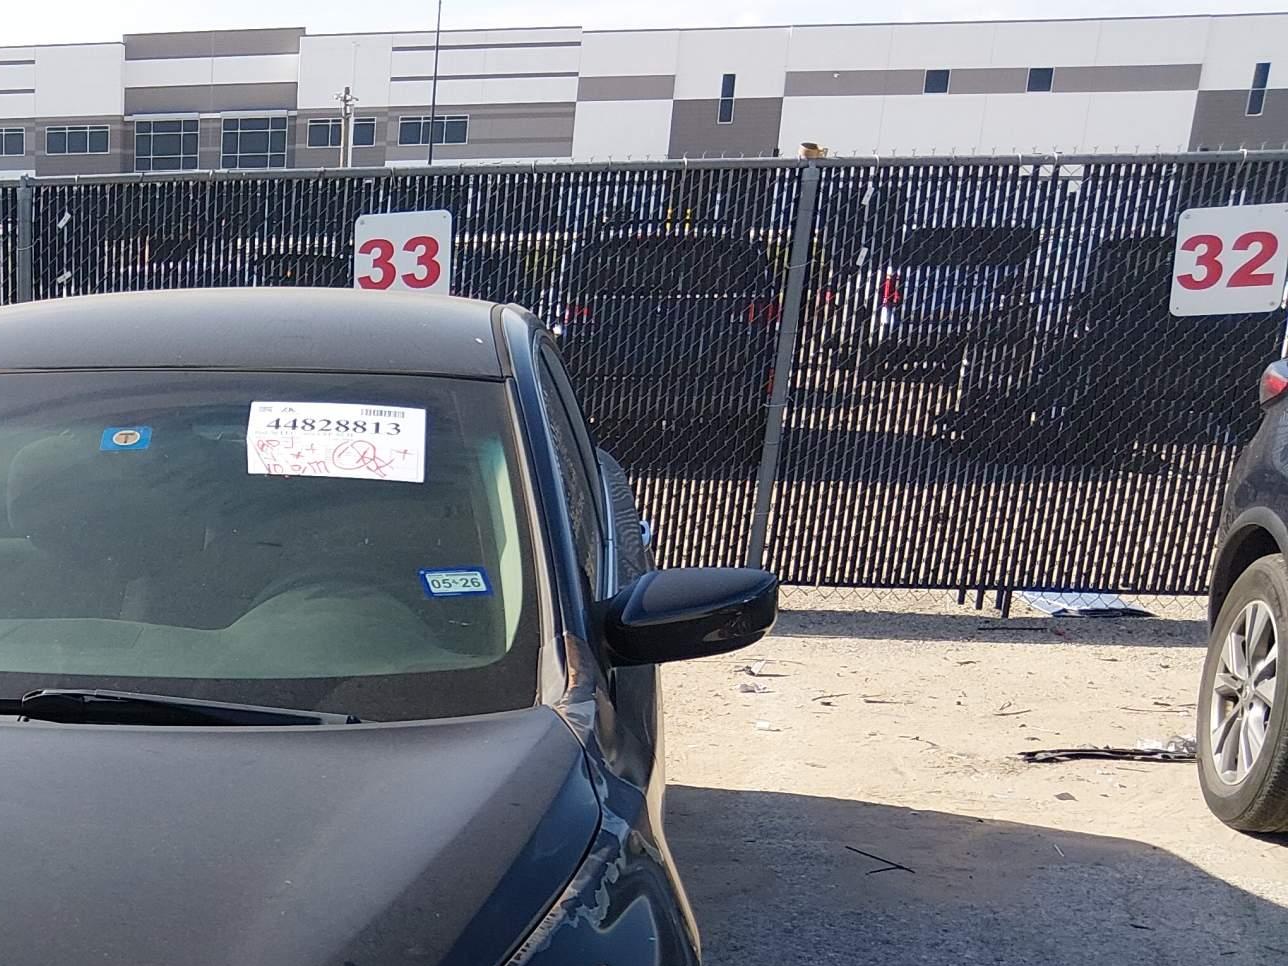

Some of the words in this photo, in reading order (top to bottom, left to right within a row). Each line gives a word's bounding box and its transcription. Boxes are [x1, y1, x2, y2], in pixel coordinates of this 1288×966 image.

[357, 235, 441, 290] 33
[1176, 231, 1279, 291] 32
[266, 417, 401, 436] 44828813
